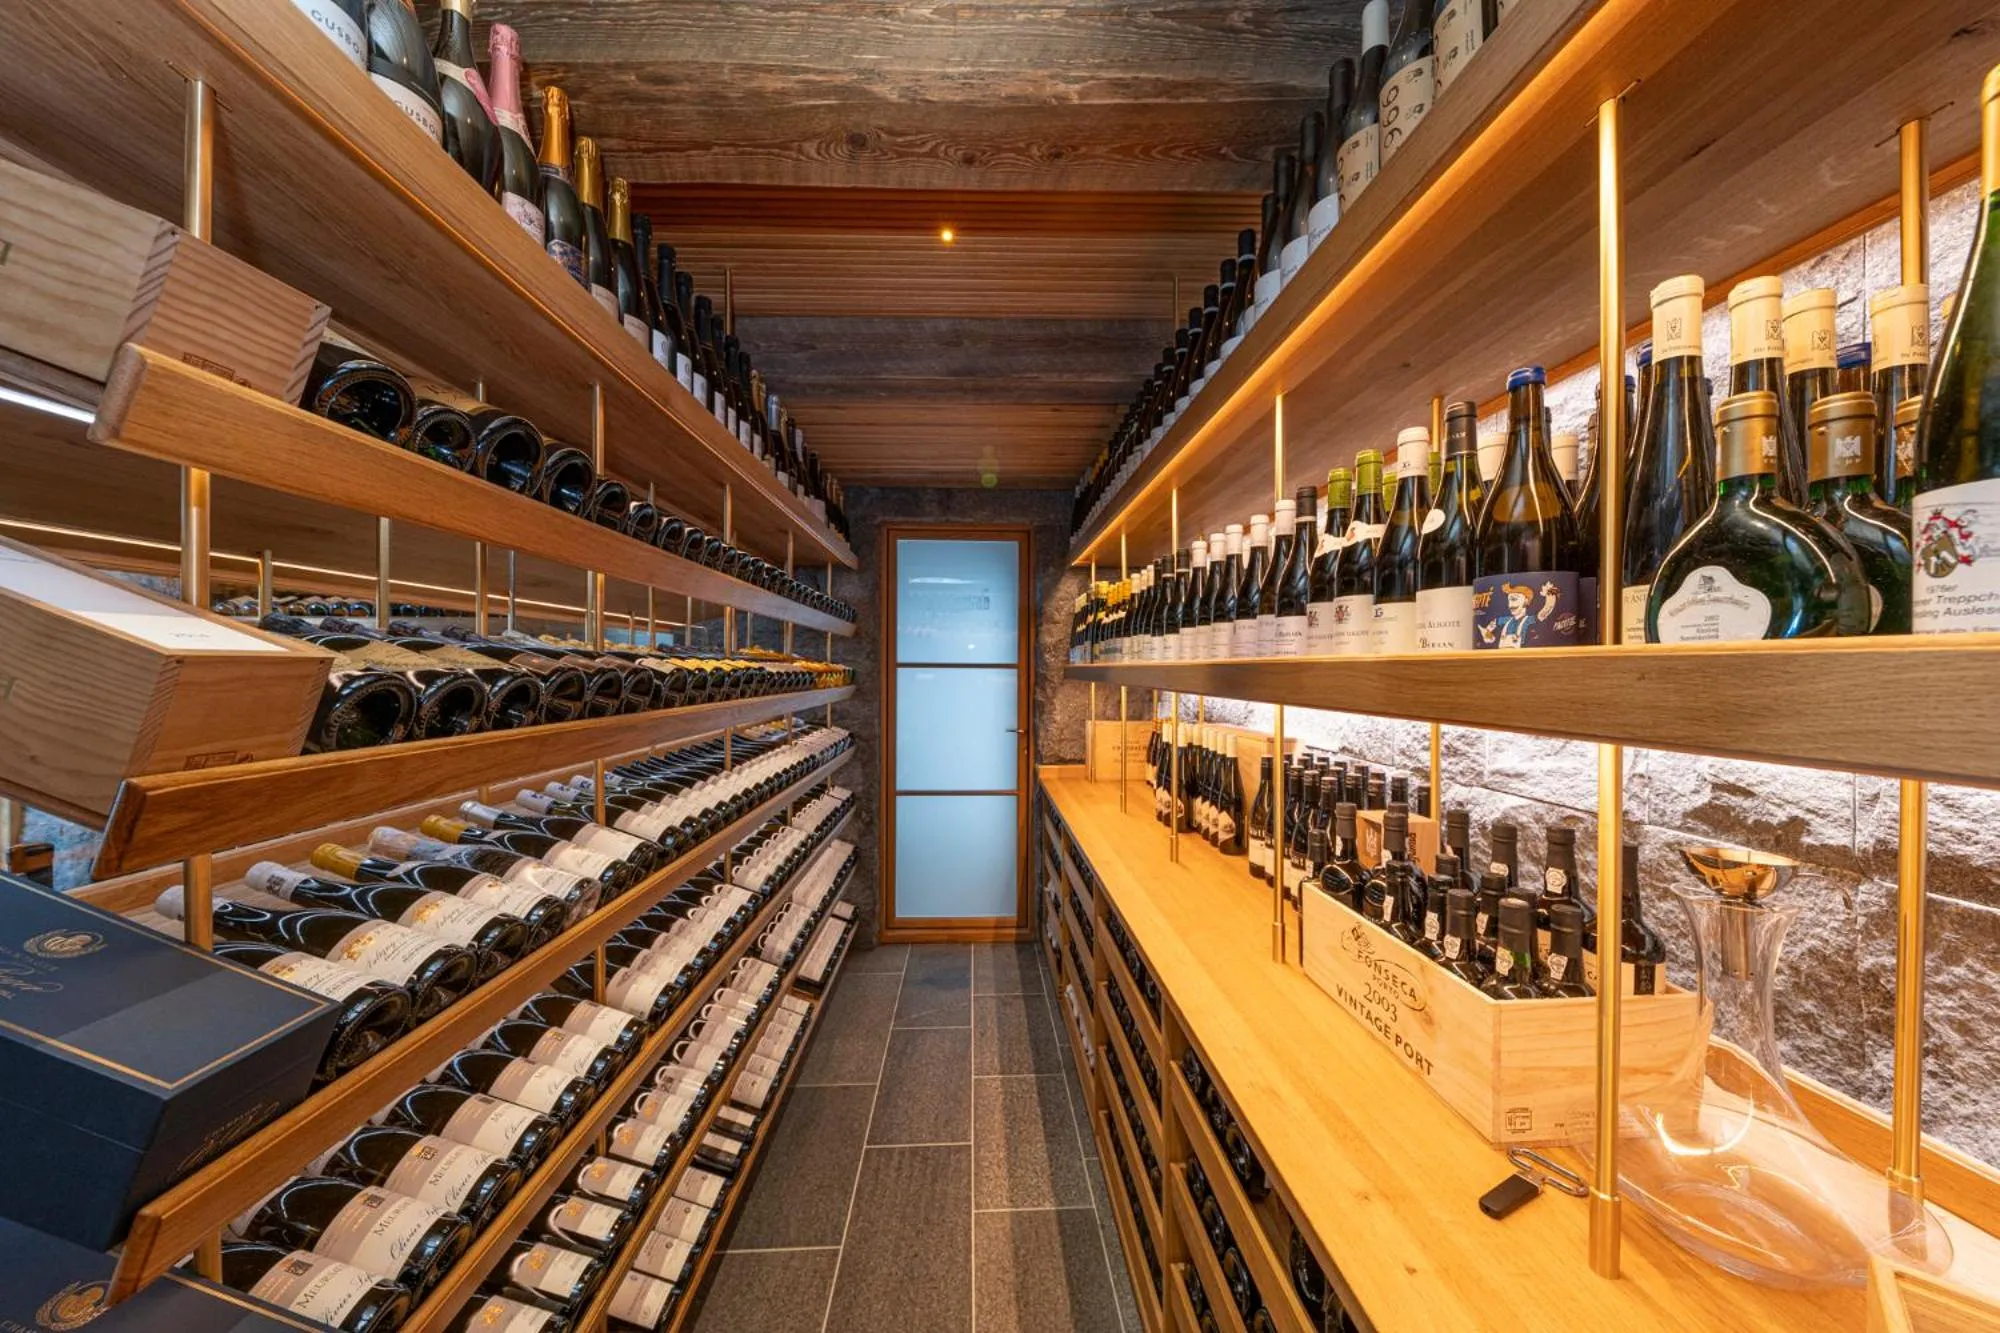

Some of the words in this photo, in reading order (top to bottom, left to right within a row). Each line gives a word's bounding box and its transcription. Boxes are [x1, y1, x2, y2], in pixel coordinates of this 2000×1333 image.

[1357, 950, 1418, 1003] FONSECA
[1363, 982, 1398, 1024] 2003
[1335, 984, 1392, 1041] VINTAGE
[1394, 1034, 1435, 1077] PORT
